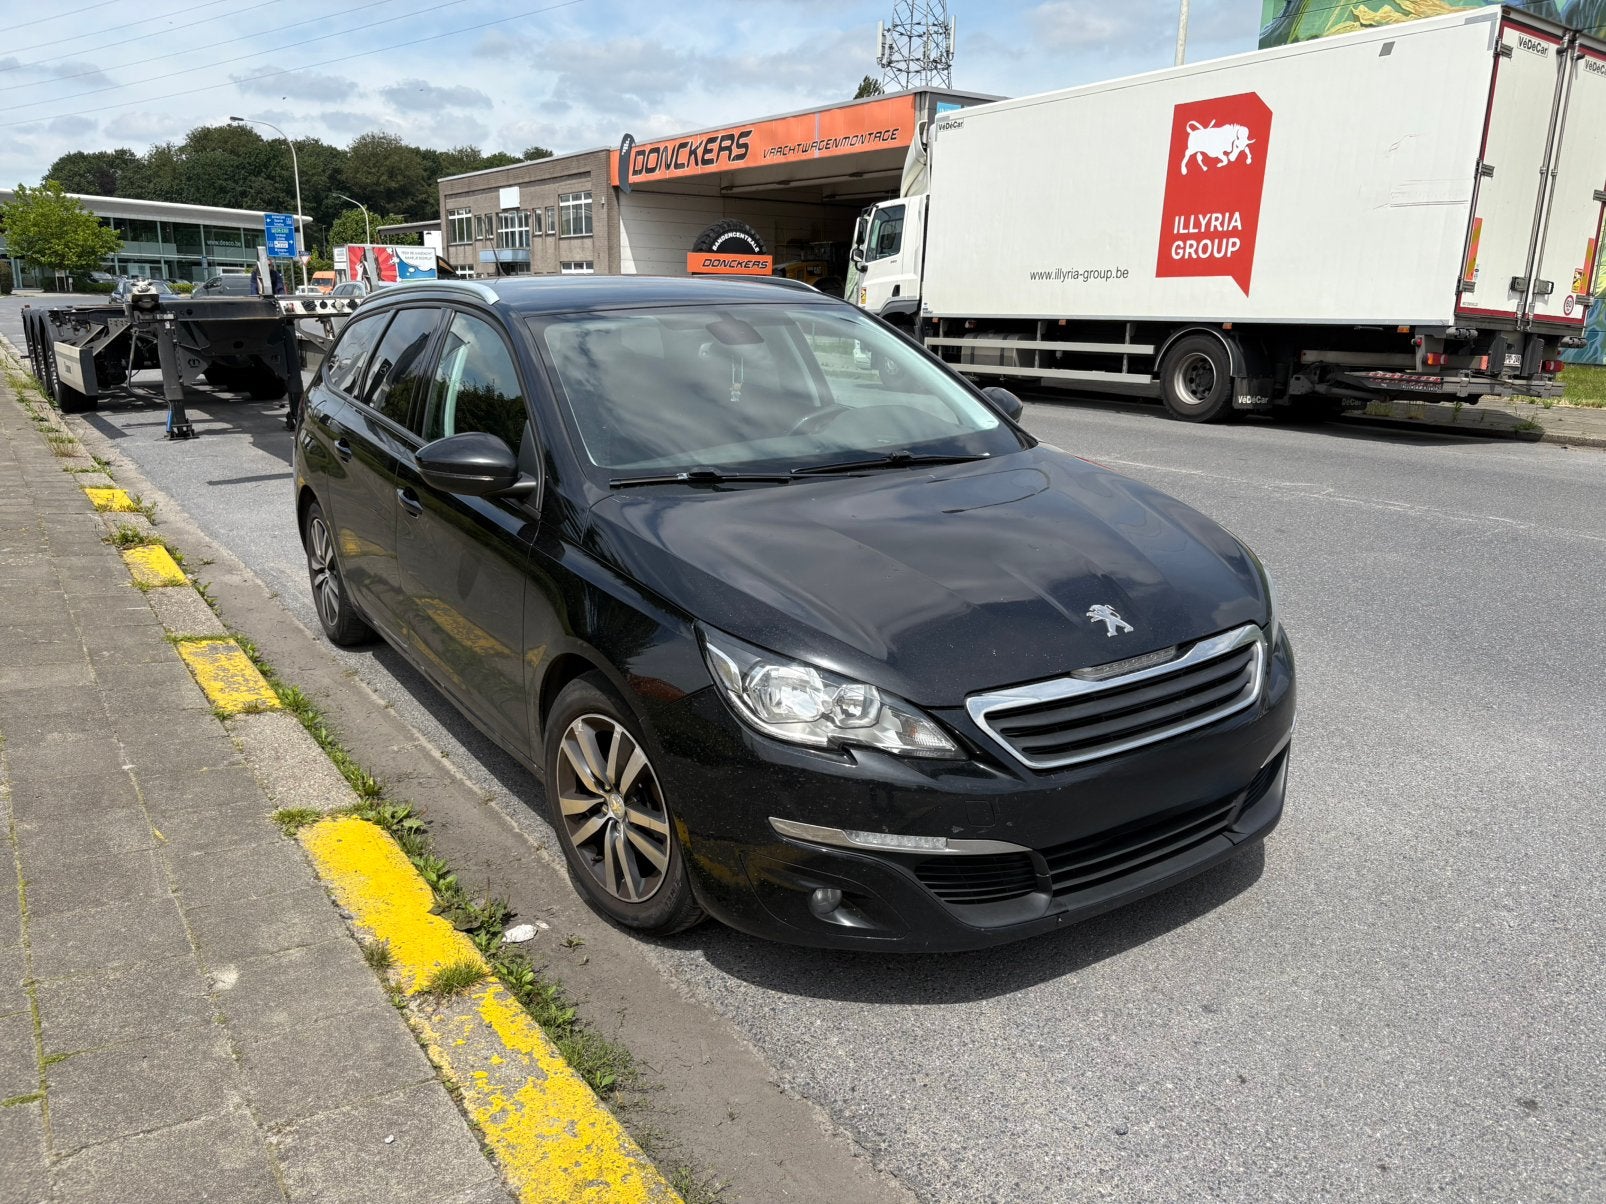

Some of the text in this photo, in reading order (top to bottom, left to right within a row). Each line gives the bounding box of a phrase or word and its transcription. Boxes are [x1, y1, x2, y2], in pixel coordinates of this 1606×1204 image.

[1518, 35, 1548, 56] VéDéCar
[1585, 59, 1606, 76] VéDéC
[631, 129, 753, 177] DONCKERS
[763, 128, 900, 159] VRACHTWAGENMONTAGE
[1173, 211, 1242, 235] ILLYRIA
[712, 231, 760, 253] BANDENCENTRALE
[1171, 237, 1241, 260] GROUP
[702, 258, 769, 269] DONCKERS
[1029, 266, 1129, 283] www.illyria-group.be
